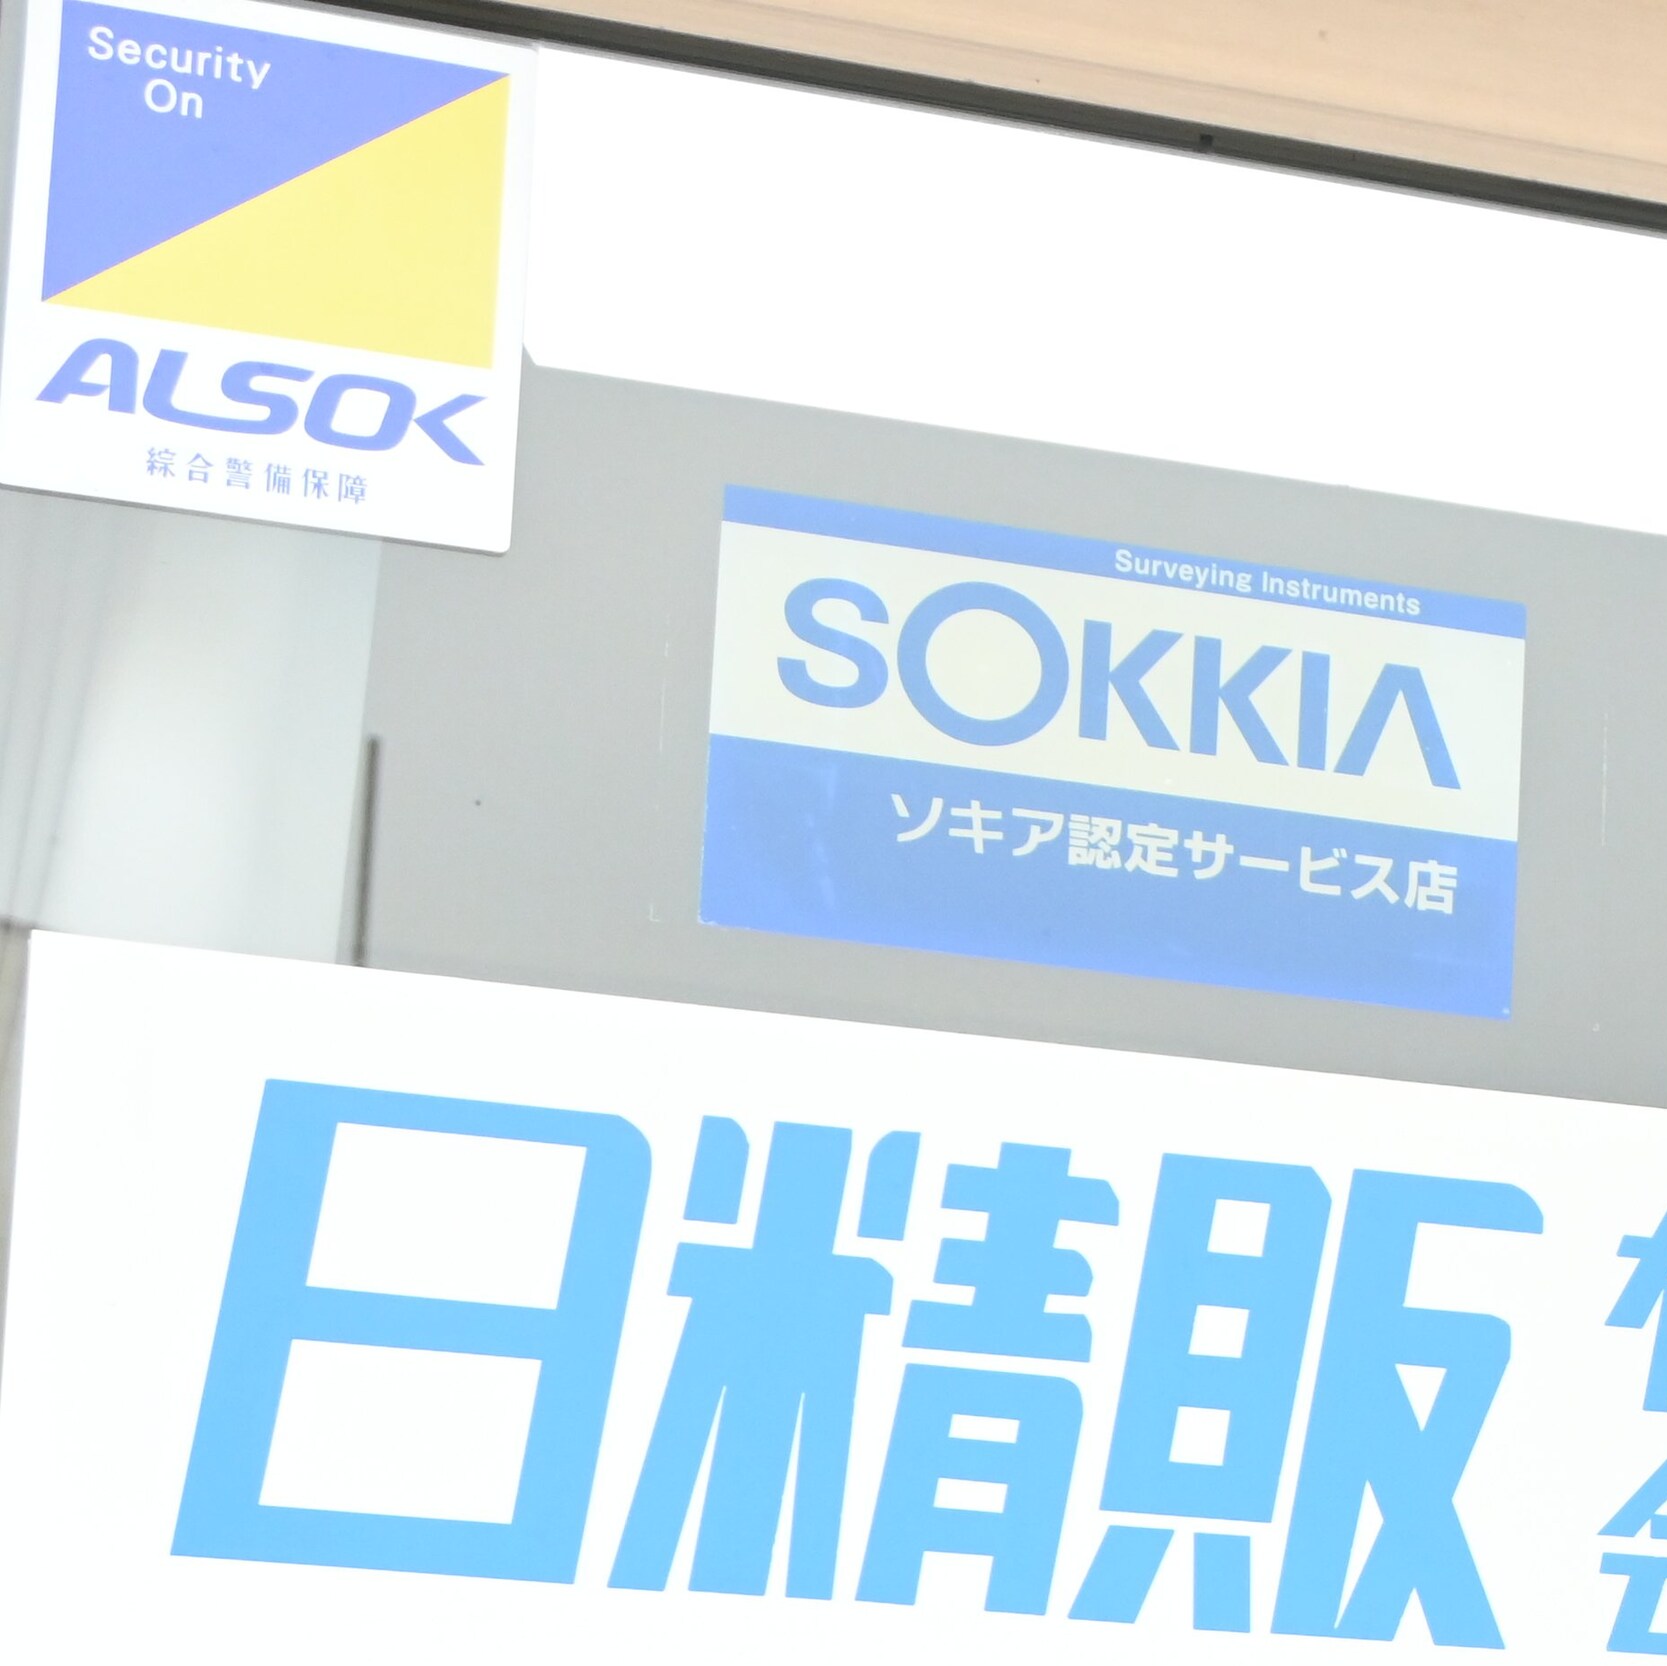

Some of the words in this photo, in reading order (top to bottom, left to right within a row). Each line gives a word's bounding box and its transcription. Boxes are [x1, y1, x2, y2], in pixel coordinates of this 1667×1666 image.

[87, 26, 272, 89] Security
[144, 78, 203, 119] On
[36, 337, 488, 467] ALSOK
[146, 447, 368, 504] 綜合警備保障
[1114, 548, 1253, 593] Surveying
[1261, 570, 1422, 616] Instruments
[776, 577, 1462, 790] SOKKIA
[891, 792, 1459, 915] ソキア認定サービス店
[169, 1078, 1545, 1650] 日精販
